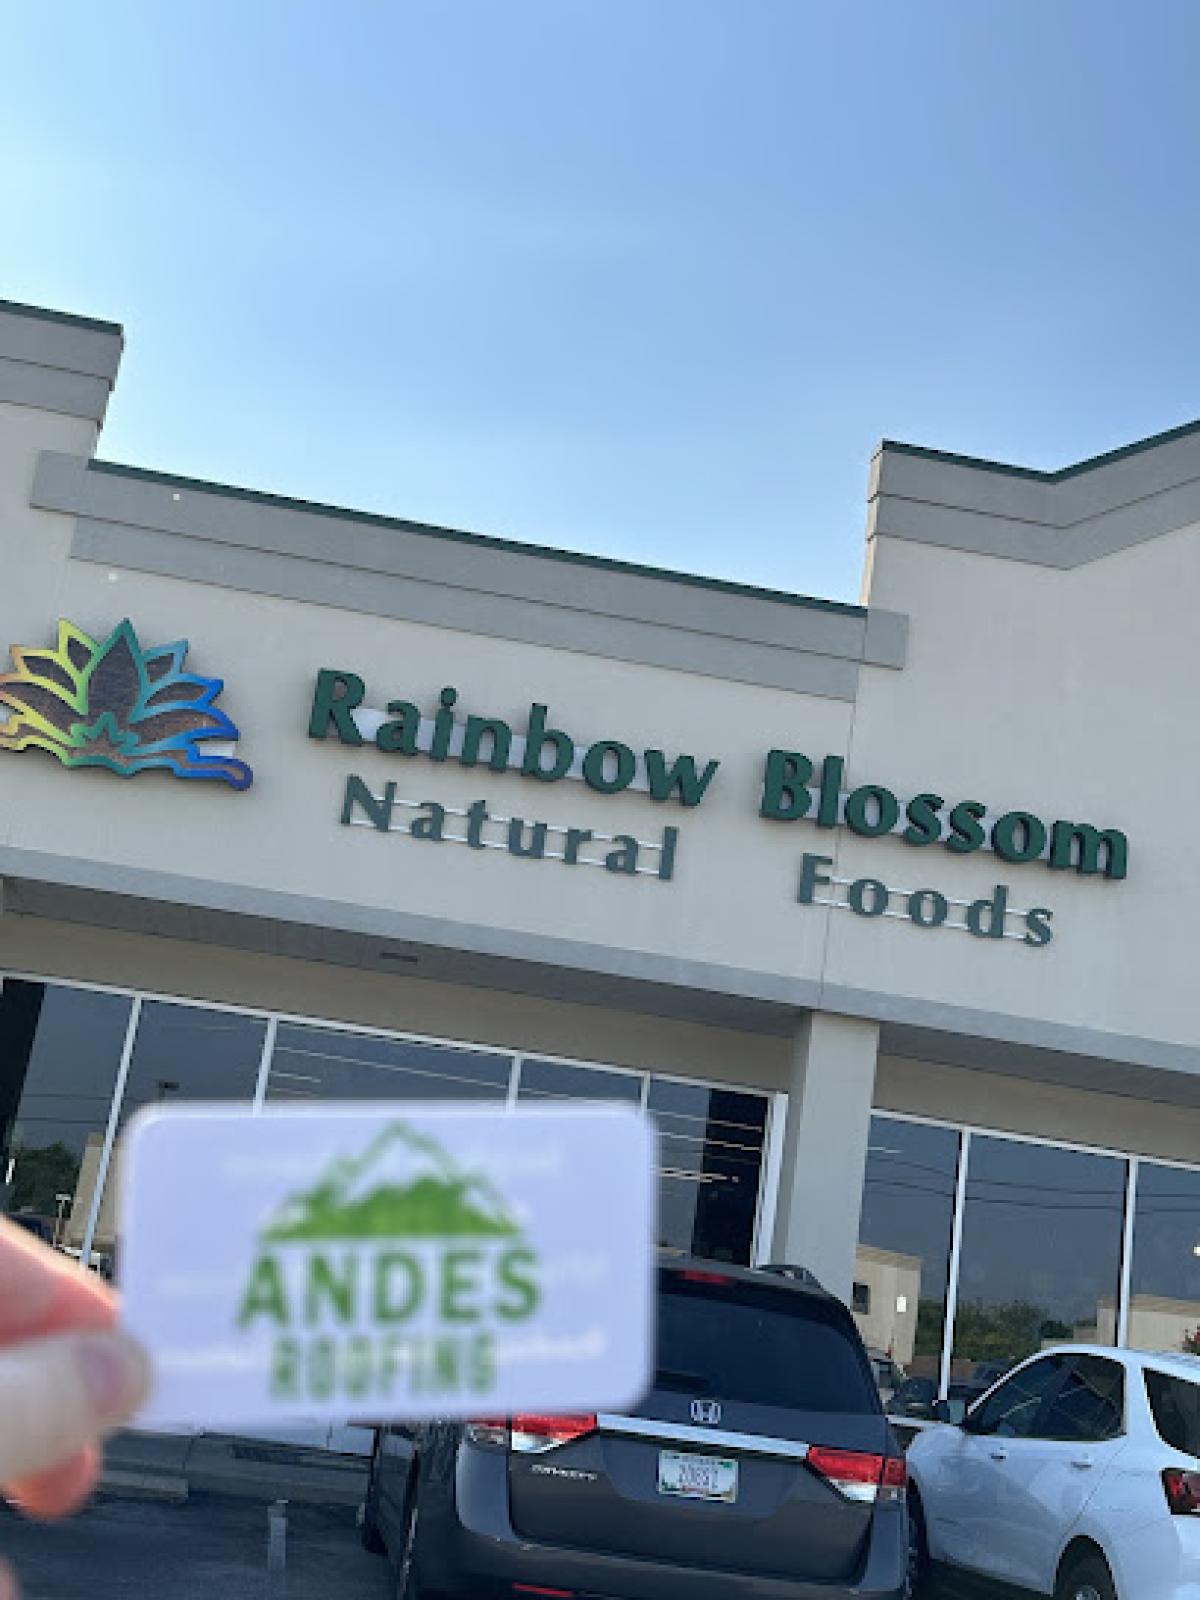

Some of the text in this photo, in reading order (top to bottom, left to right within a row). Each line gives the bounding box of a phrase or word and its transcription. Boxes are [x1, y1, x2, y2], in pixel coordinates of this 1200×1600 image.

[308, 668, 1128, 880] Rainbow Blossom
[340, 773, 1054, 947] Natural Foods
[238, 1248, 543, 1329] ANDES
[269, 1333, 498, 1398] ROOFING
